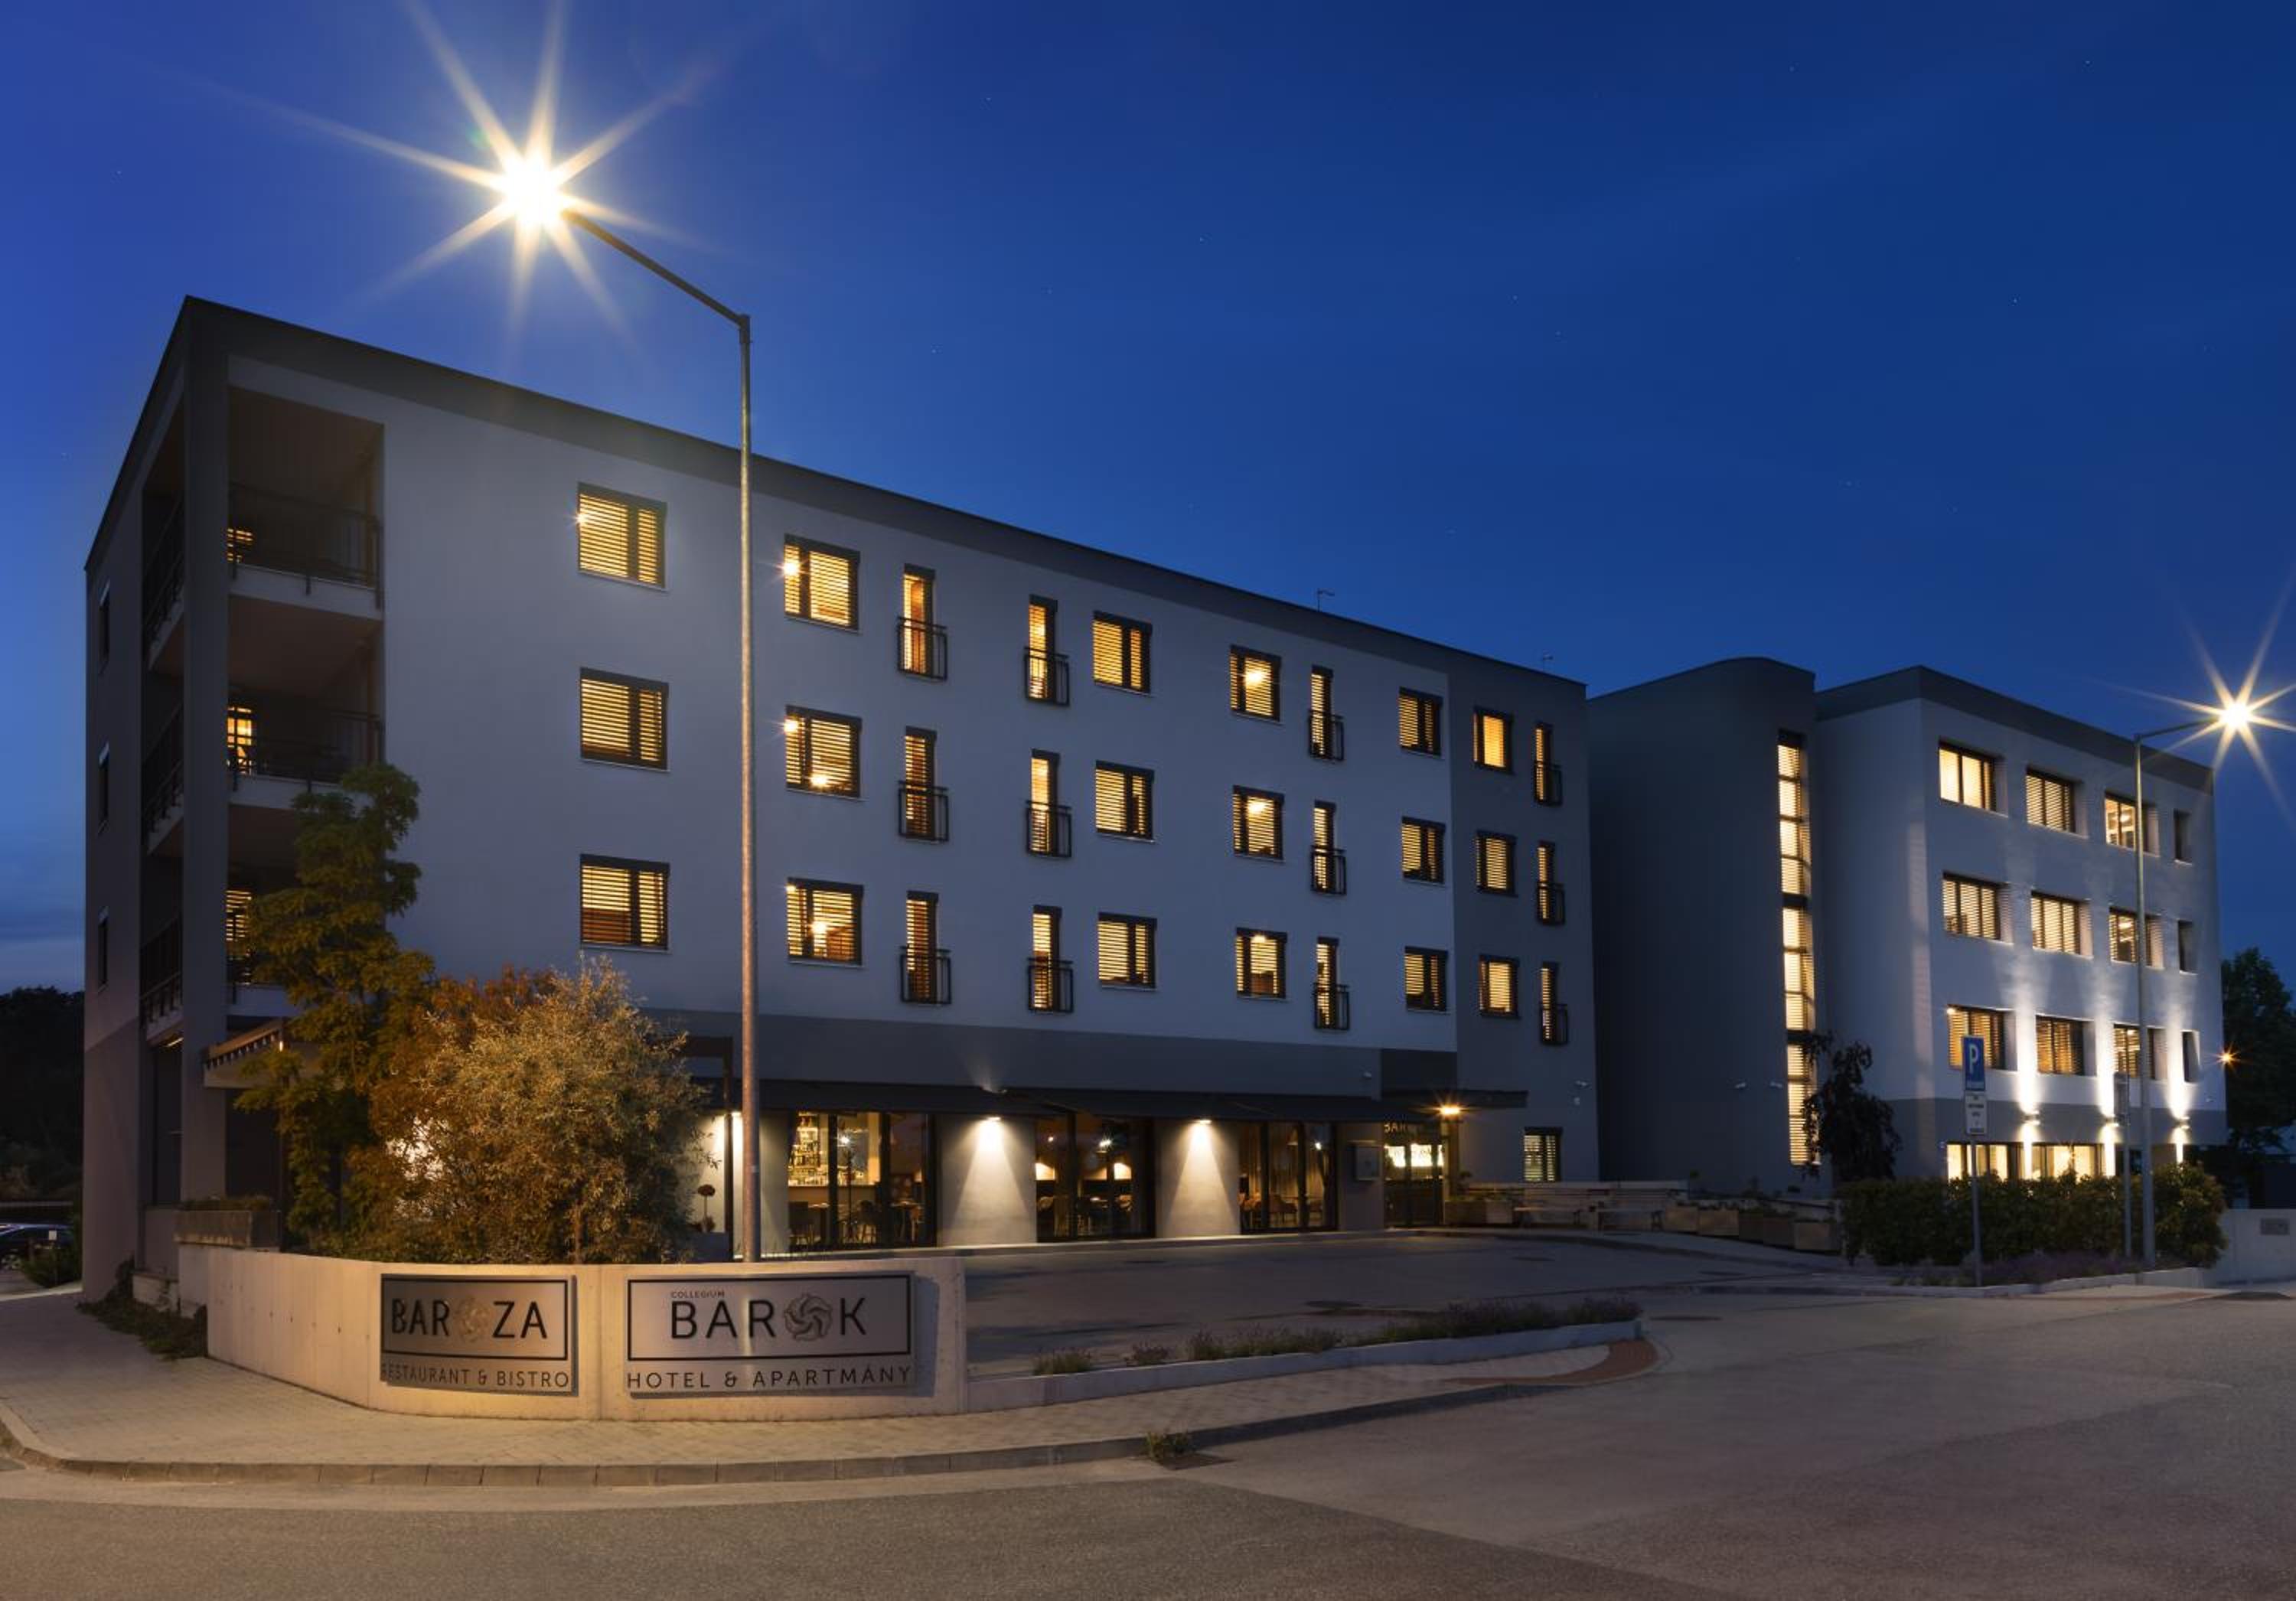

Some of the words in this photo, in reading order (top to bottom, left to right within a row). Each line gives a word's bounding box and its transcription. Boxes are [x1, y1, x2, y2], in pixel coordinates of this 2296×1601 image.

[1968, 1043, 1978, 1073] P
[478, 1371, 488, 1386] &
[497, 1371, 569, 1387] BISTRO
[627, 1371, 710, 1388] HOTEL
[724, 1371, 737, 1387] &
[753, 1362, 911, 1387] APARTMÁNY
